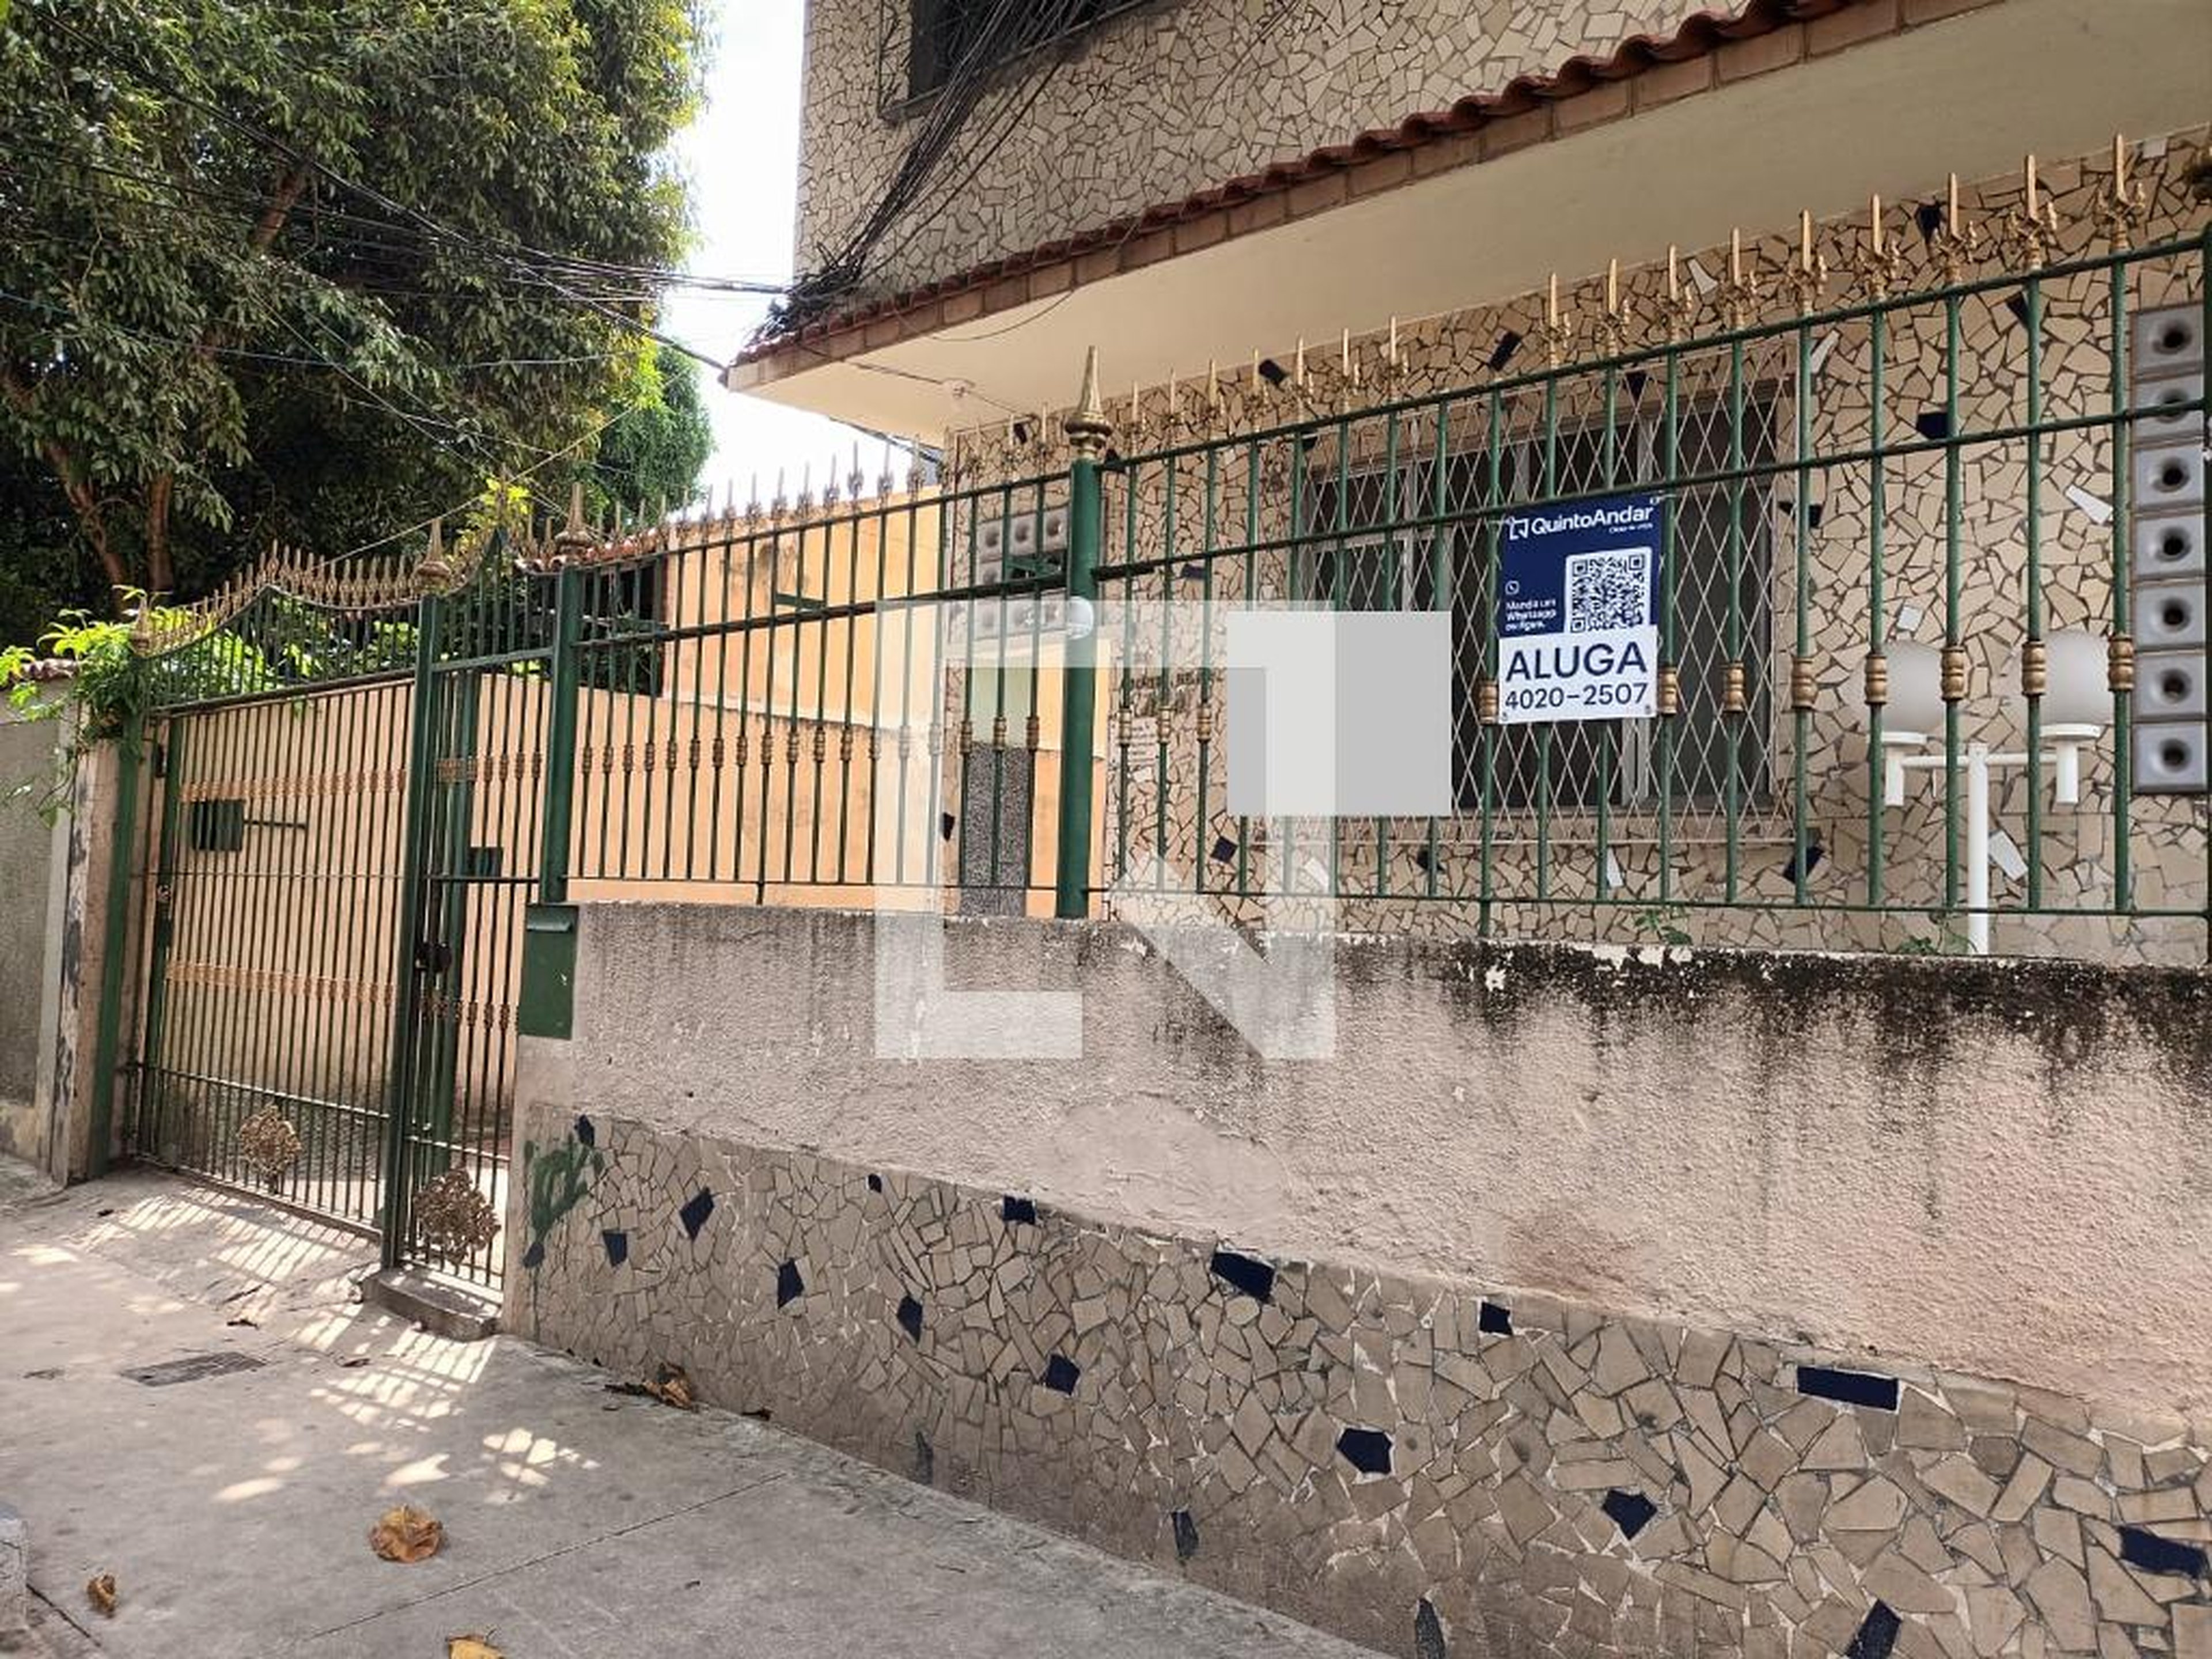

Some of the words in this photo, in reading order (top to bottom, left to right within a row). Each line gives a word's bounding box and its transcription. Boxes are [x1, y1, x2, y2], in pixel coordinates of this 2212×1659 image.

[1531, 505, 1654, 535] QuintoAndar
[1505, 641, 1647, 682] ALUGA
[1505, 683, 1648, 709] 4020-2507
